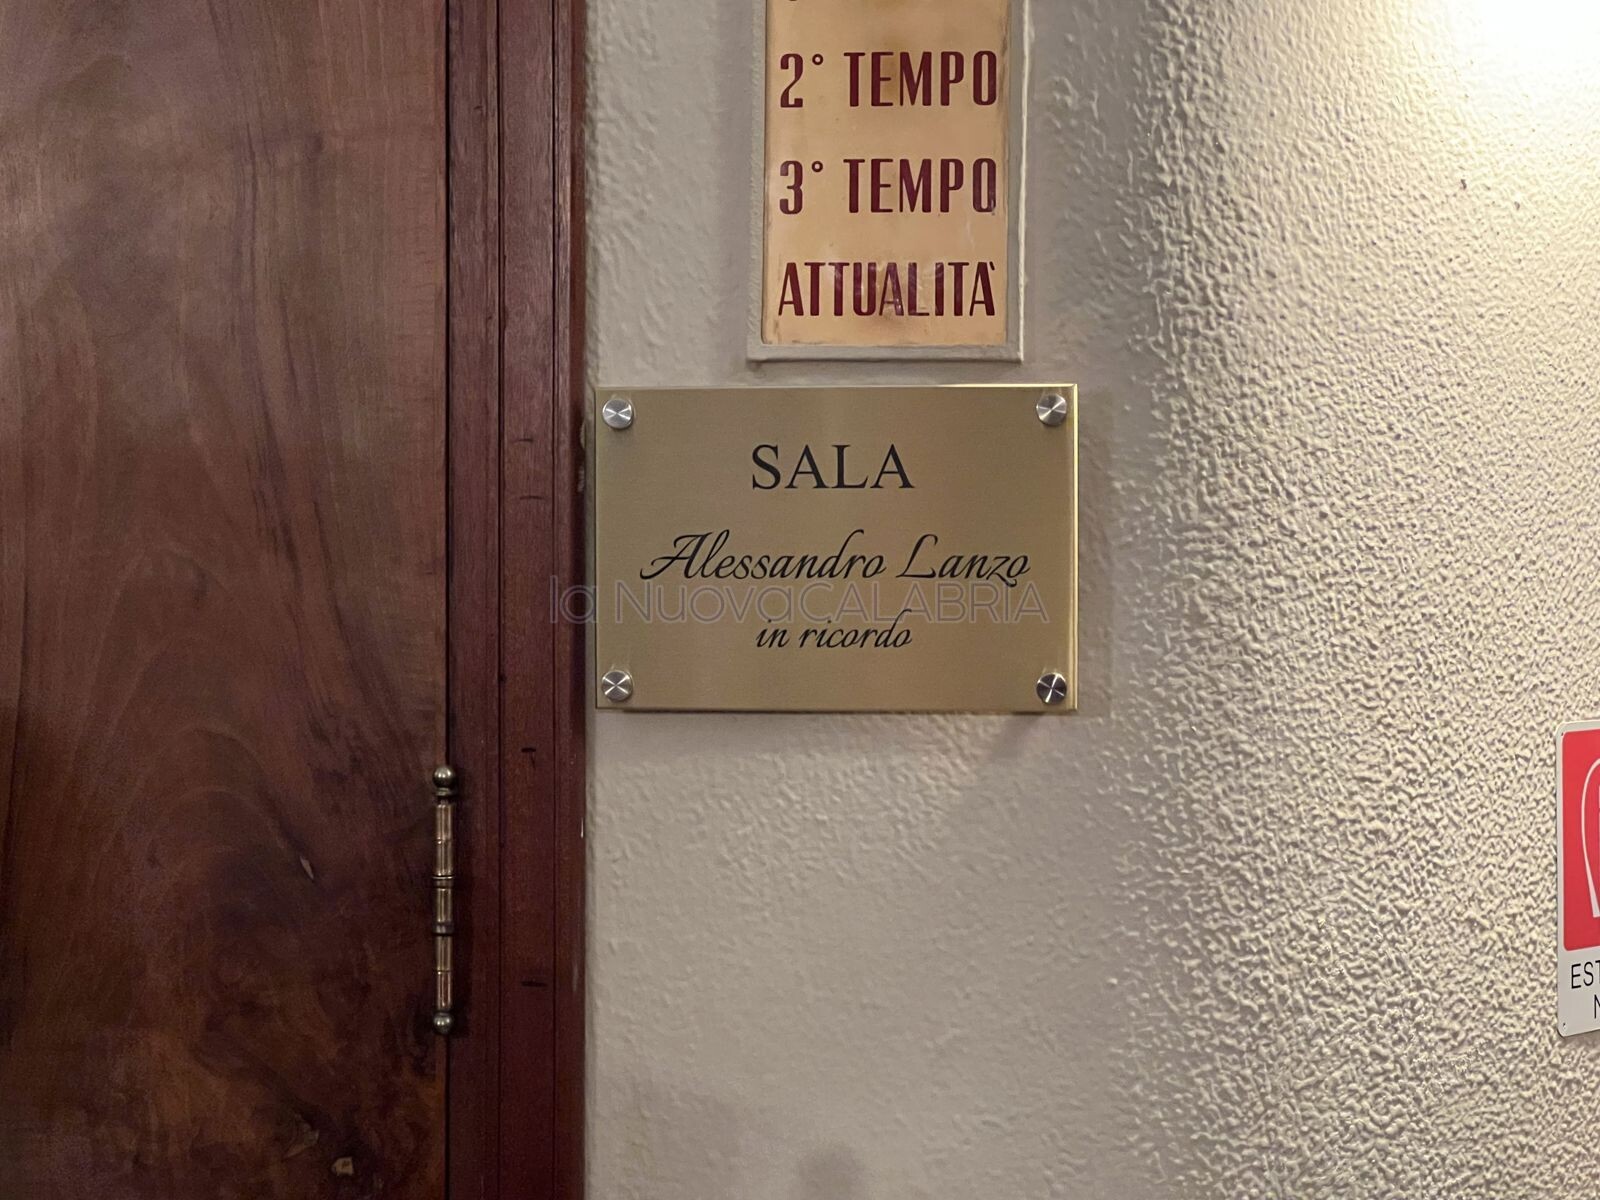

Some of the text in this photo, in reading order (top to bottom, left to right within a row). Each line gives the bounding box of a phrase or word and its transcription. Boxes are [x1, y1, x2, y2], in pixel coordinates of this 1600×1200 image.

[780, 50, 997, 108] 2° TEMPO
[779, 157, 997, 215] 3° TEMPO
[751, 443, 915, 490] SALA
[639, 529, 1031, 588] Alessandro Lanzo
[756, 608, 913, 649] in ricordo
